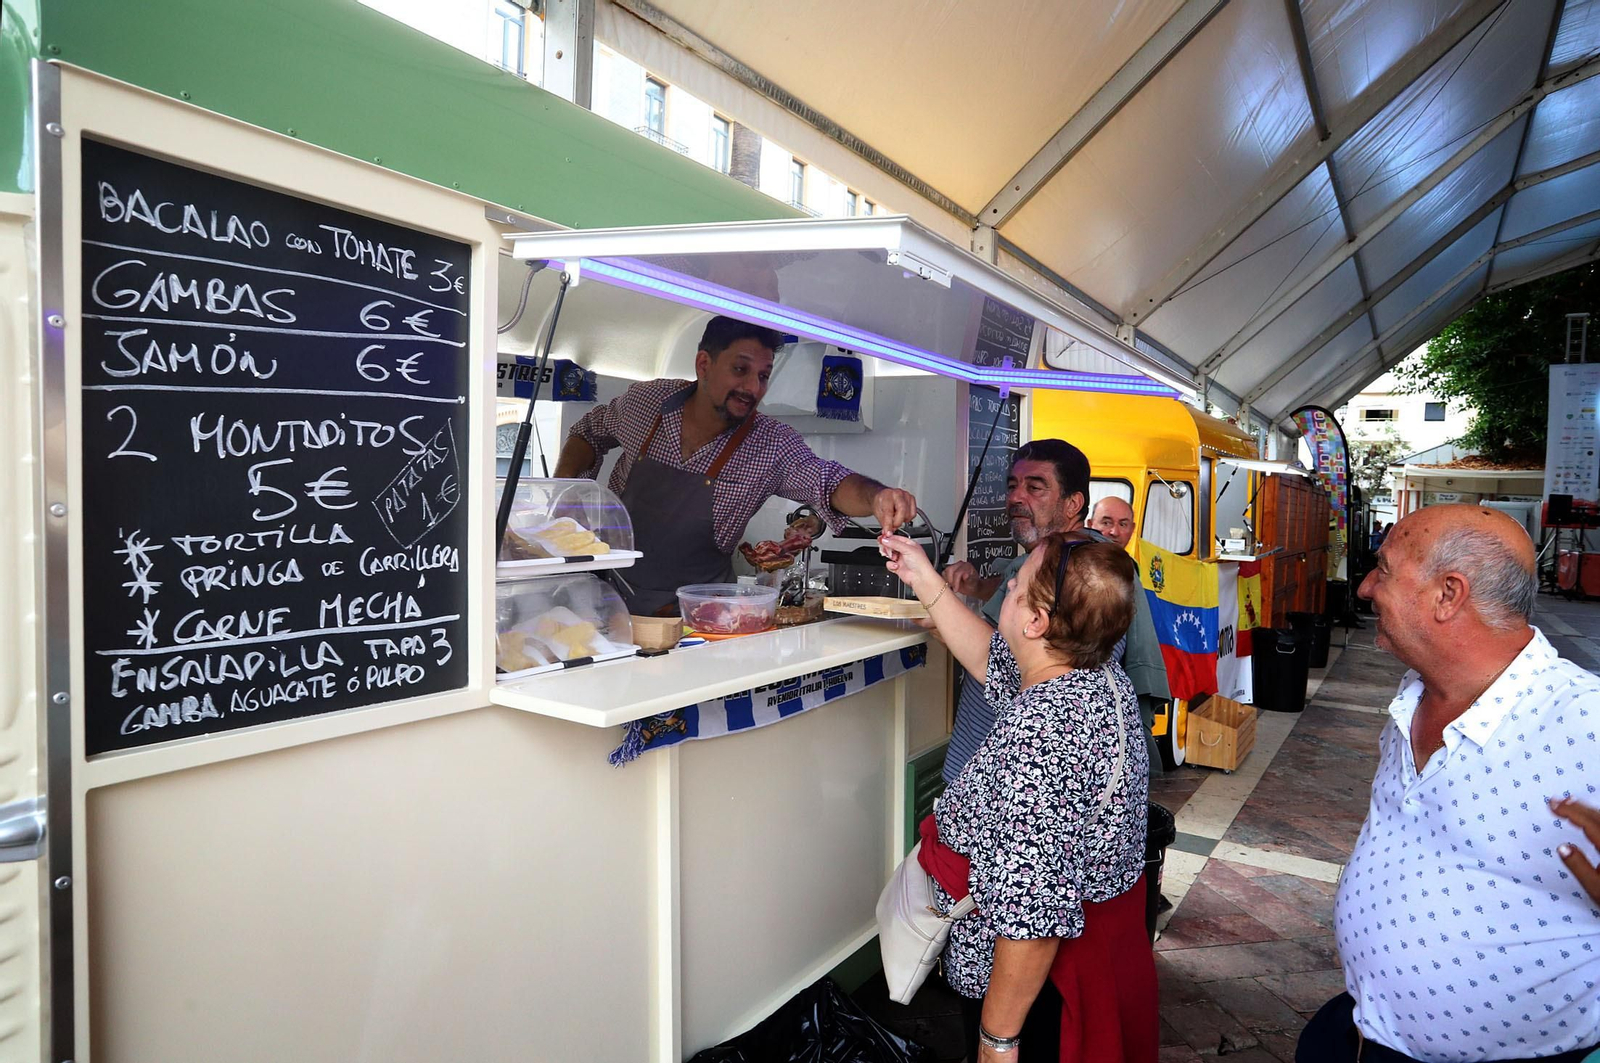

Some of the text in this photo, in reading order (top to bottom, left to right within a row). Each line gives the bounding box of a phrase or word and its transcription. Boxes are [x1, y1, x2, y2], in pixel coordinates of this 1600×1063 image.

[98, 180, 270, 249] BACALAO
[318, 224, 419, 281] TOMATE
[92, 259, 297, 323] GAMBAS
[107, 405, 427, 462] 2 MONTADITOS
[1011, 403, 1018, 422] 3
[385, 431, 450, 523] PATATAS
[171, 523, 354, 555] TORTILLA
[180, 558, 305, 598] PRINGA
[321, 561, 345, 577] DE
[172, 607, 292, 644] CARNE
[111, 628, 453, 698] ENSALADILLA TAPA 3
[230, 673, 338, 713] AGUACATE
[366, 663, 425, 691] PULPO
